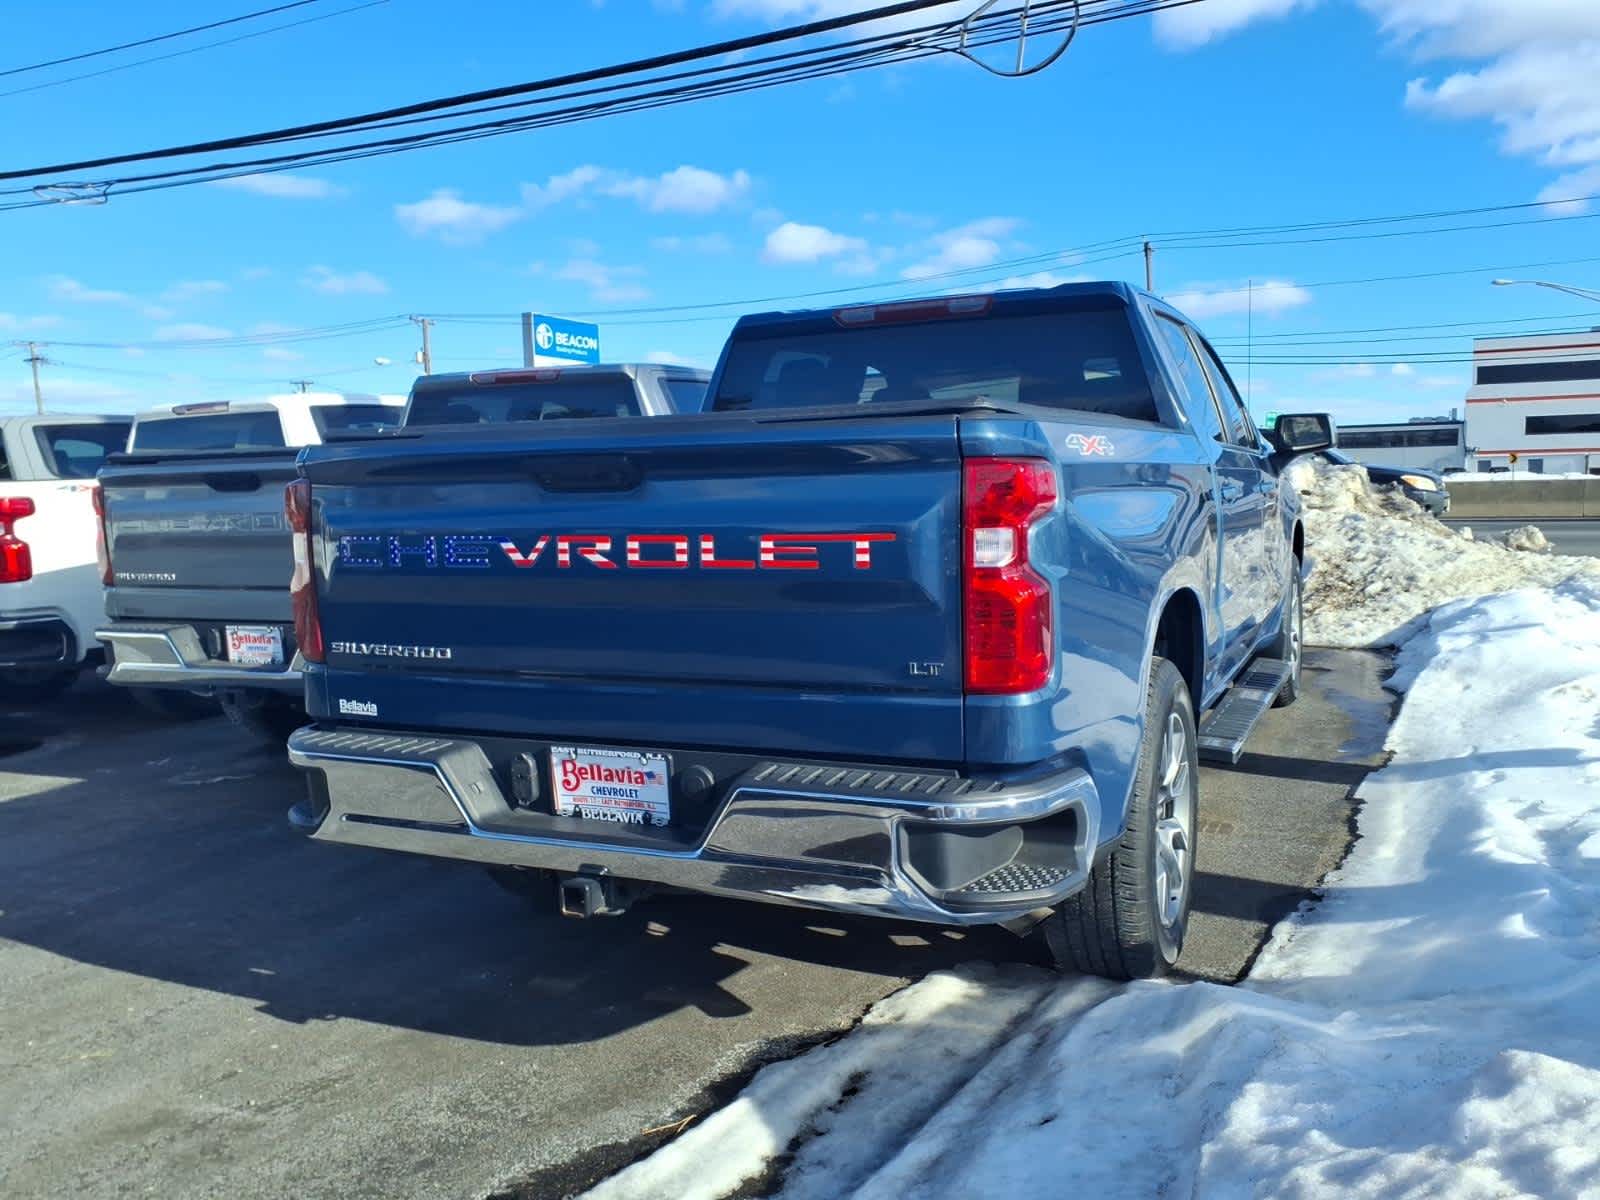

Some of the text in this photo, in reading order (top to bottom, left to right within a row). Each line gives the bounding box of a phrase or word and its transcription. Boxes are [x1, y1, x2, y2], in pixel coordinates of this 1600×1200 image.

[555, 332, 598, 349] BEACON
[339, 532, 897, 569] CHEVROLET
[331, 641, 452, 659] SILVERADO
[909, 662, 944, 676] LT
[339, 698, 378, 714] Bellavia
[561, 758, 646, 792] Bellavia
[591, 785, 640, 799] CHEVROLET
[581, 808, 644, 824] BELLAVIA
